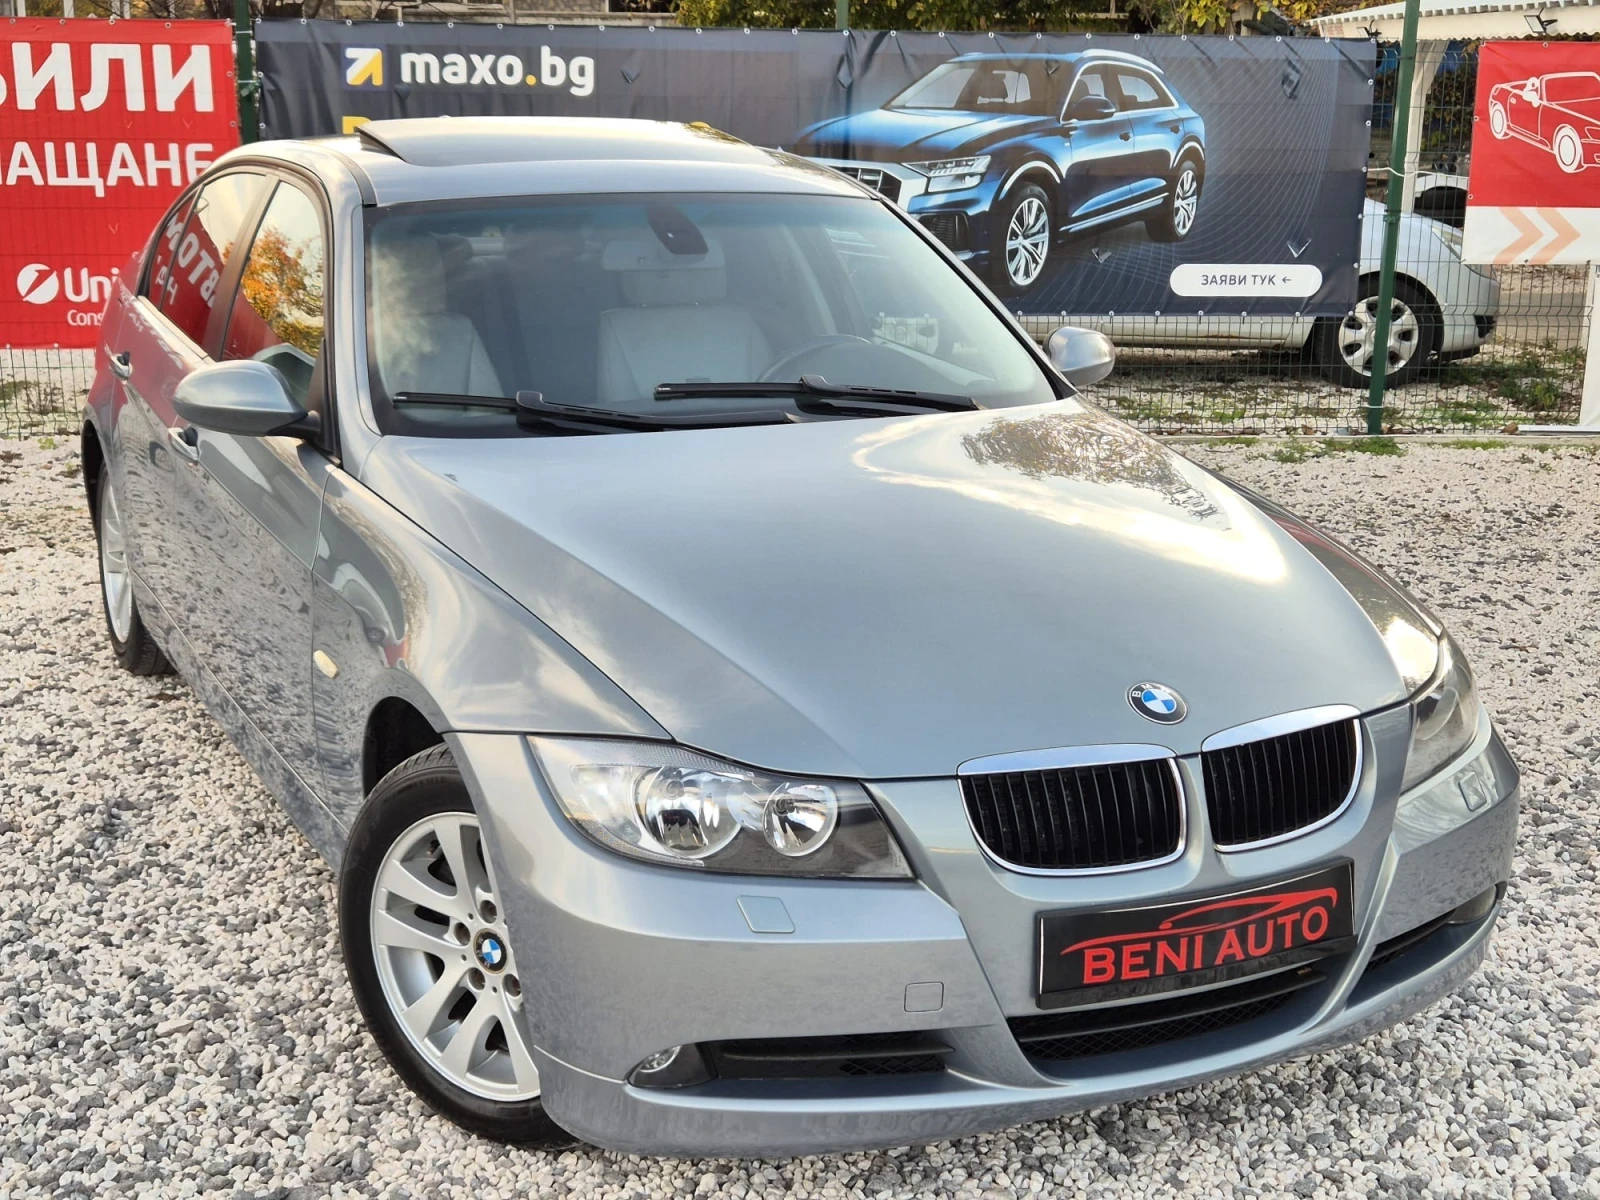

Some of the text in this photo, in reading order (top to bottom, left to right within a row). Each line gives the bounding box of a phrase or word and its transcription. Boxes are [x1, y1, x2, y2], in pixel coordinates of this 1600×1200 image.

[0, 42, 214, 112] ИЛИ
[400, 45, 595, 97] maxo.bg
[0, 141, 214, 198] АЩАНЕ
[1200, 274, 1277, 286] ЗАЯВИ ТУК
[1082, 905, 1329, 985] BENI AUTO
